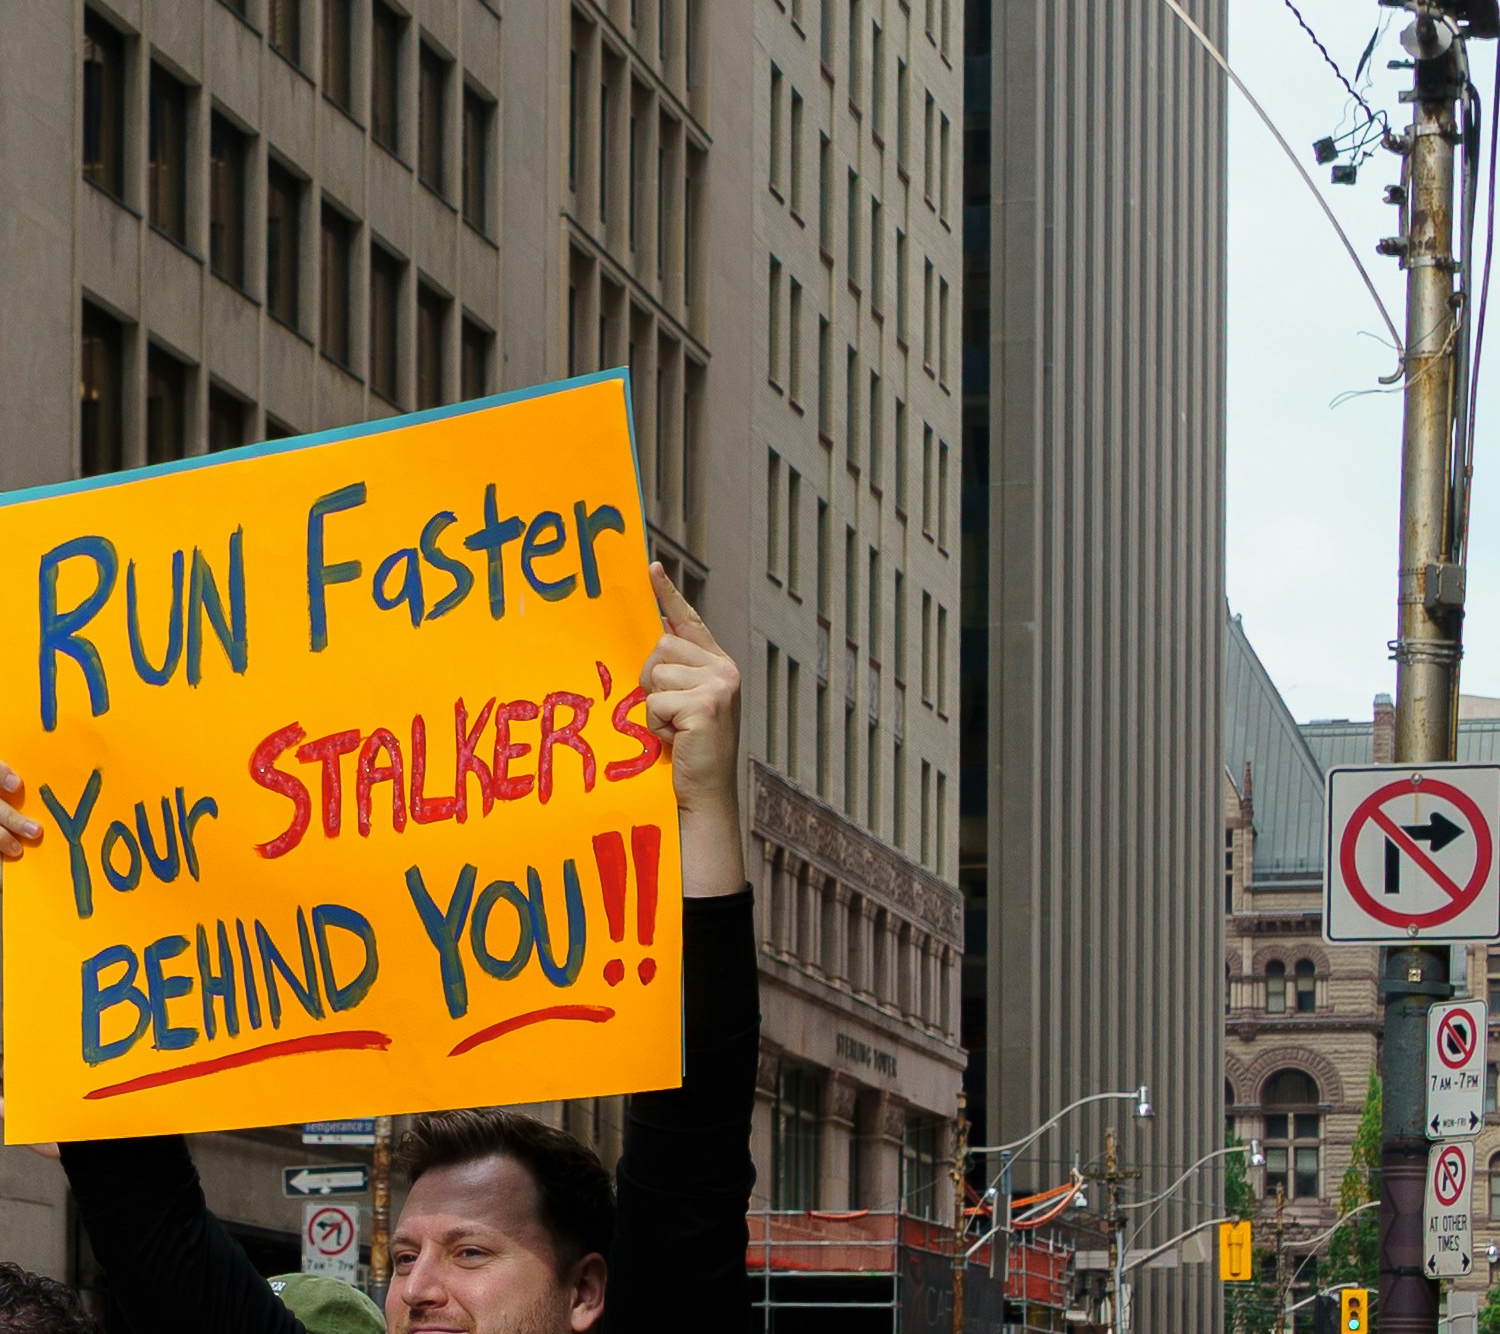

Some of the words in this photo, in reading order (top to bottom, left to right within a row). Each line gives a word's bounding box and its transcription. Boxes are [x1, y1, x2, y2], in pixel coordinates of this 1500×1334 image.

[38, 524, 249, 732] RUN
[306, 481, 626, 653] Faster
[39, 767, 218, 920] Your
[249, 660, 663, 860] STALKER'S
[81, 903, 379, 1066] BEHIND
[404, 824, 662, 1020] YOU!!
[873, 1049, 897, 1079] TOWER
[1430, 1216, 1439, 1232] AT
[1443, 1214, 1467, 1232] OTHER
[1438, 1234, 1460, 1252] TIMES
